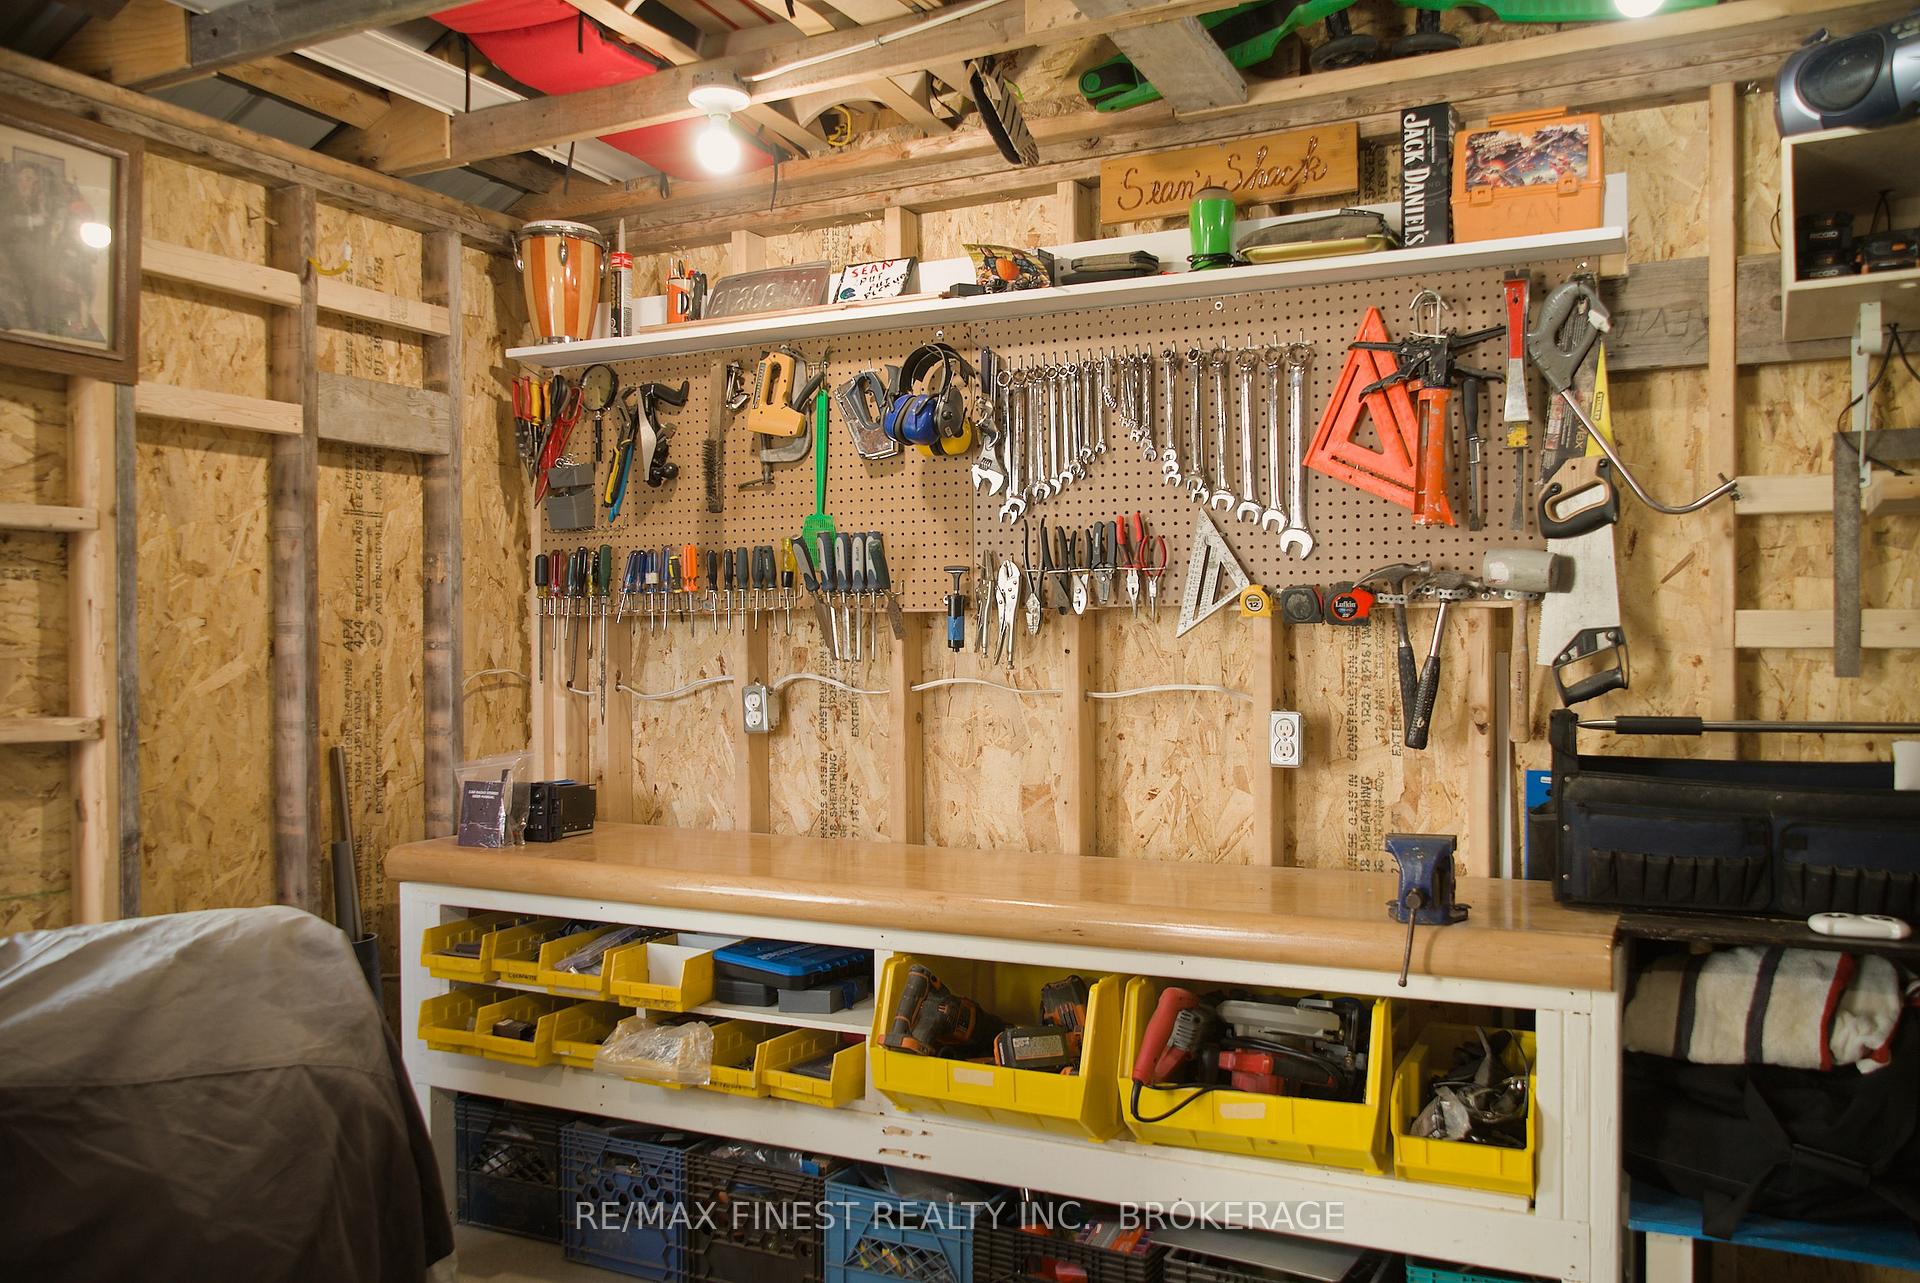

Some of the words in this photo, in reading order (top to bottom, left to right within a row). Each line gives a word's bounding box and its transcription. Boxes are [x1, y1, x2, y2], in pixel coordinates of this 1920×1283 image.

[1222, 135, 1328, 192] Shack
[1404, 114, 1430, 165] JACK
[1404, 167, 1430, 247] DANIEL'S
[852, 259, 894, 278] SEAN
